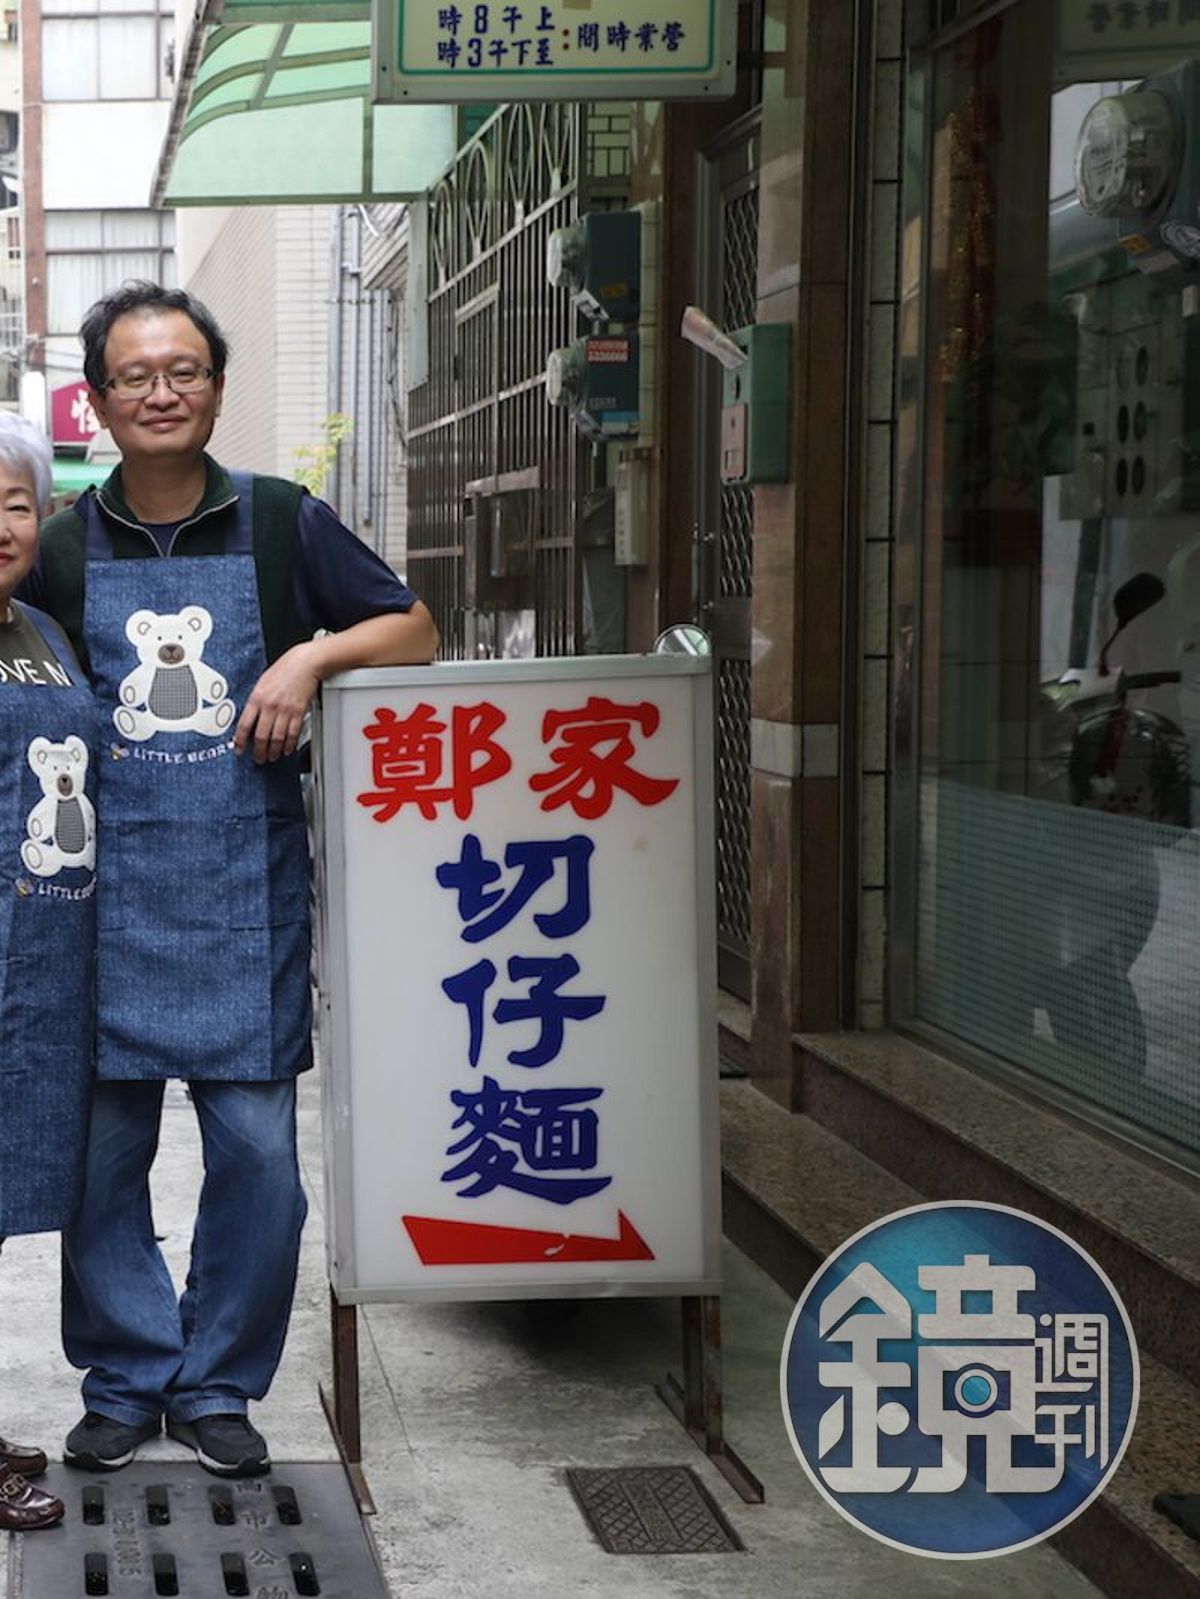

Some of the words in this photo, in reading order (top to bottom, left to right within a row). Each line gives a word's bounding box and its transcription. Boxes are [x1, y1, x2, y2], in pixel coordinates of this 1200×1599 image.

[133, 747, 184, 764] LITTLE
[356, 697, 680, 823] 鄭家
[436, 834, 612, 1205] 切仔麵
